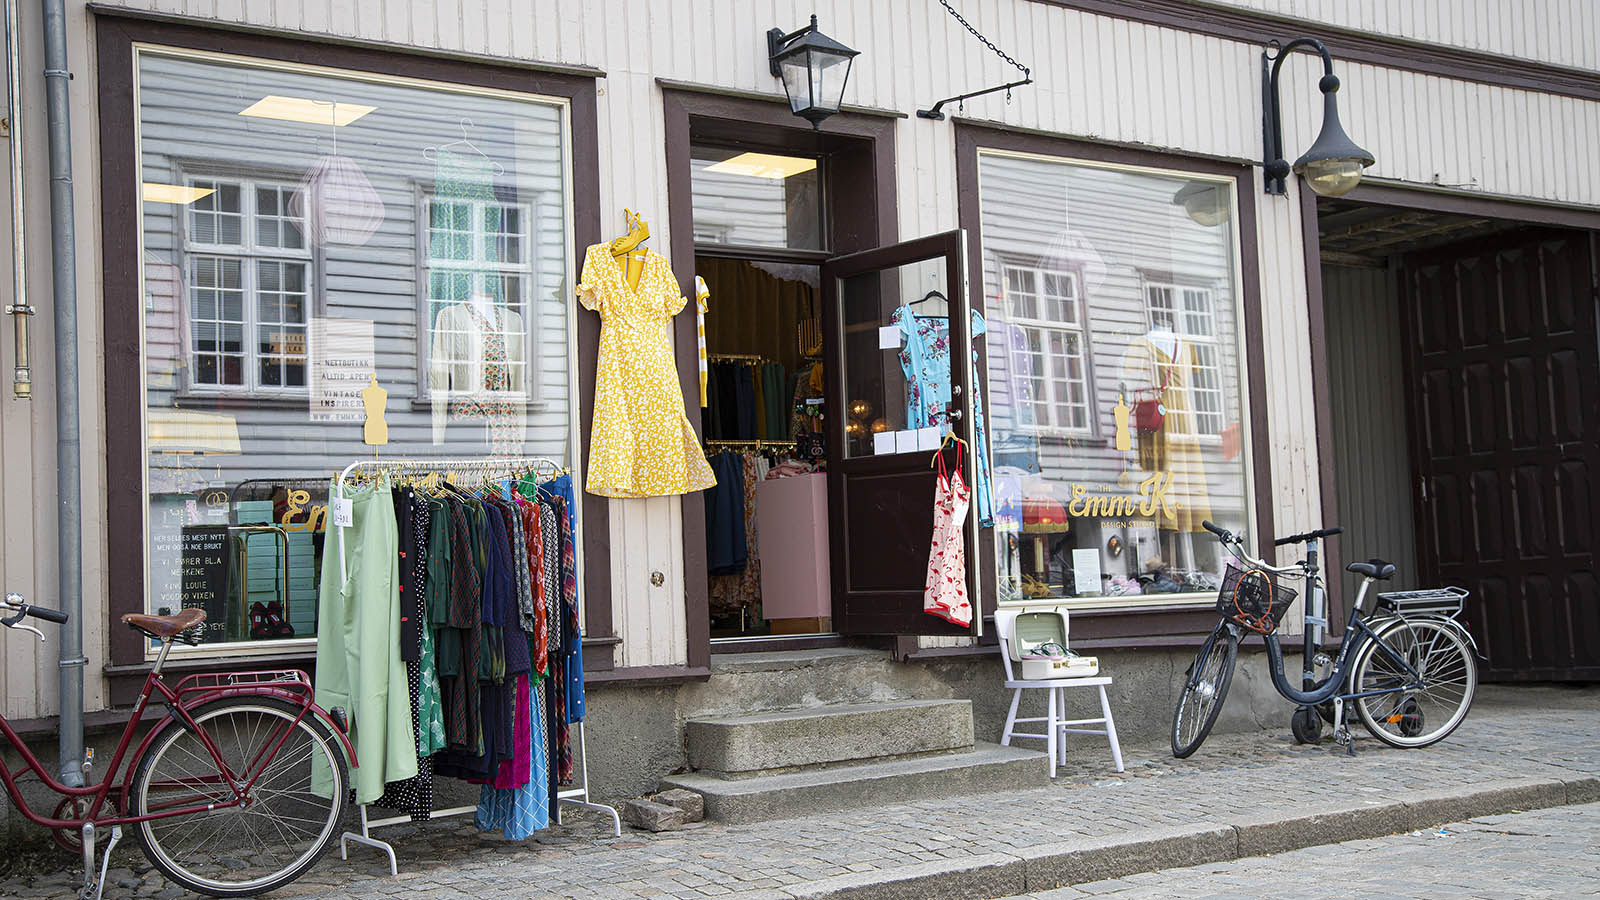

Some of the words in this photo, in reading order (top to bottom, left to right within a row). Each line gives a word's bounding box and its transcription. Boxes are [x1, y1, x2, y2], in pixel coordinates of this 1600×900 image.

[325, 359, 369, 367] NETTBUTIKK
[324, 390, 361, 398] VINTAGE
[1097, 485, 1112, 493] THE
[1069, 482, 1136, 517] Emm
[1101, 521, 1127, 529] DESIGN
[210, 533, 226, 541] NYTT
[203, 542, 222, 550] BRUKT
[171, 568, 205, 576] MERKENE
[185, 581, 207, 590] LOUIE
[161, 592, 190, 601] VOODOO
[192, 591, 215, 600] VIXEN
